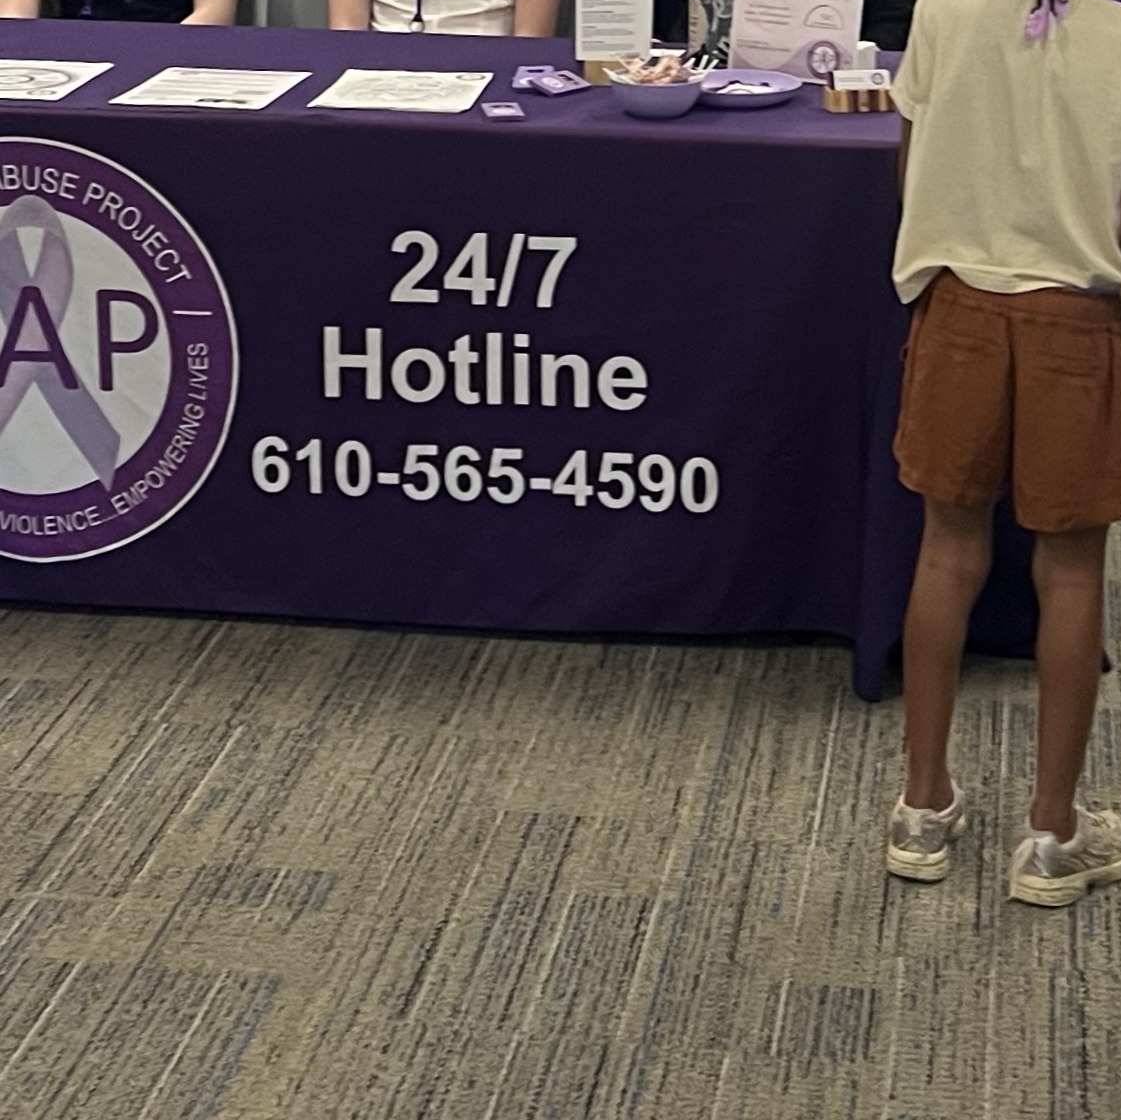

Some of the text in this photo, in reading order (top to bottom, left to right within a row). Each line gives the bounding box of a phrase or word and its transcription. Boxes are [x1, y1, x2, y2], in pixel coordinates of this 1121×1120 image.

[0, 164, 193, 283] BUSE PROJECT
[389, 229, 578, 308] 24/7
[0, 285, 159, 391] AP
[322, 325, 648, 410] Hotline
[110, 403, 205, 515] EMPOWERING
[187, 342, 210, 401] LIVES
[251, 435, 720, 513] 610-565-4590
